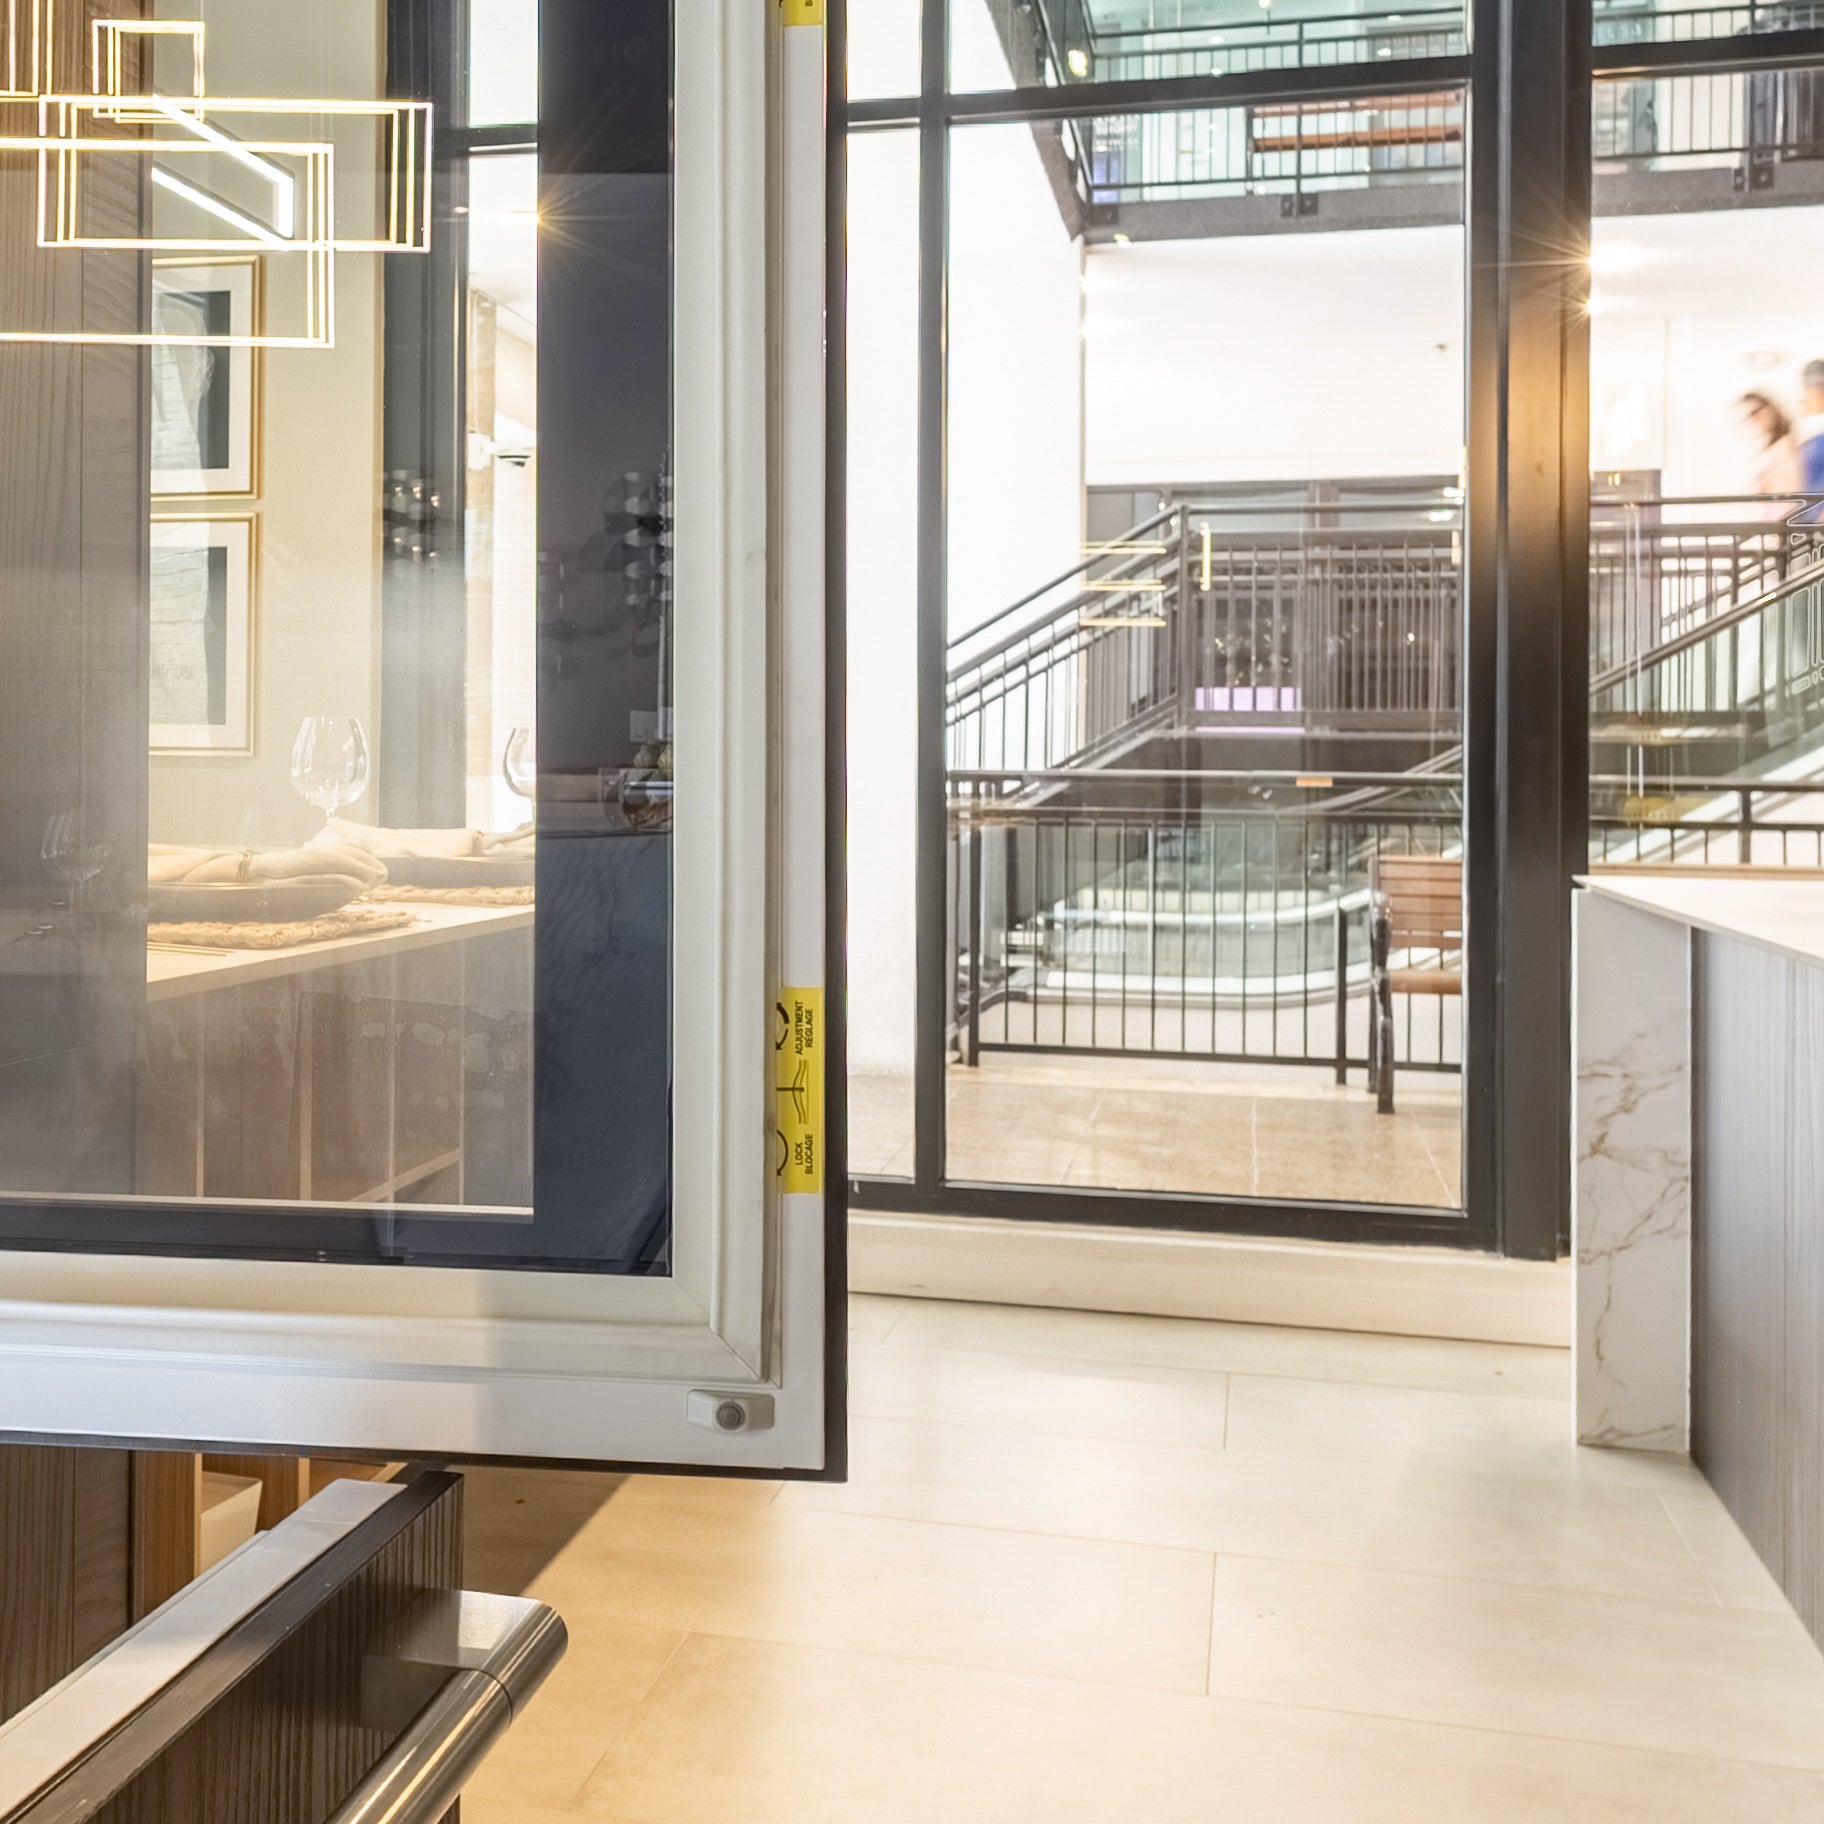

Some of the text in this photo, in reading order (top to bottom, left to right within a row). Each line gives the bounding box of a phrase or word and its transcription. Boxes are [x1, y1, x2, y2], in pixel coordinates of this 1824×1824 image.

[795, 1000, 804, 1055] ADJUSTMENT
[795, 1142, 804, 1165] LOCK
[805, 1133, 814, 1175] BLOCAGE
